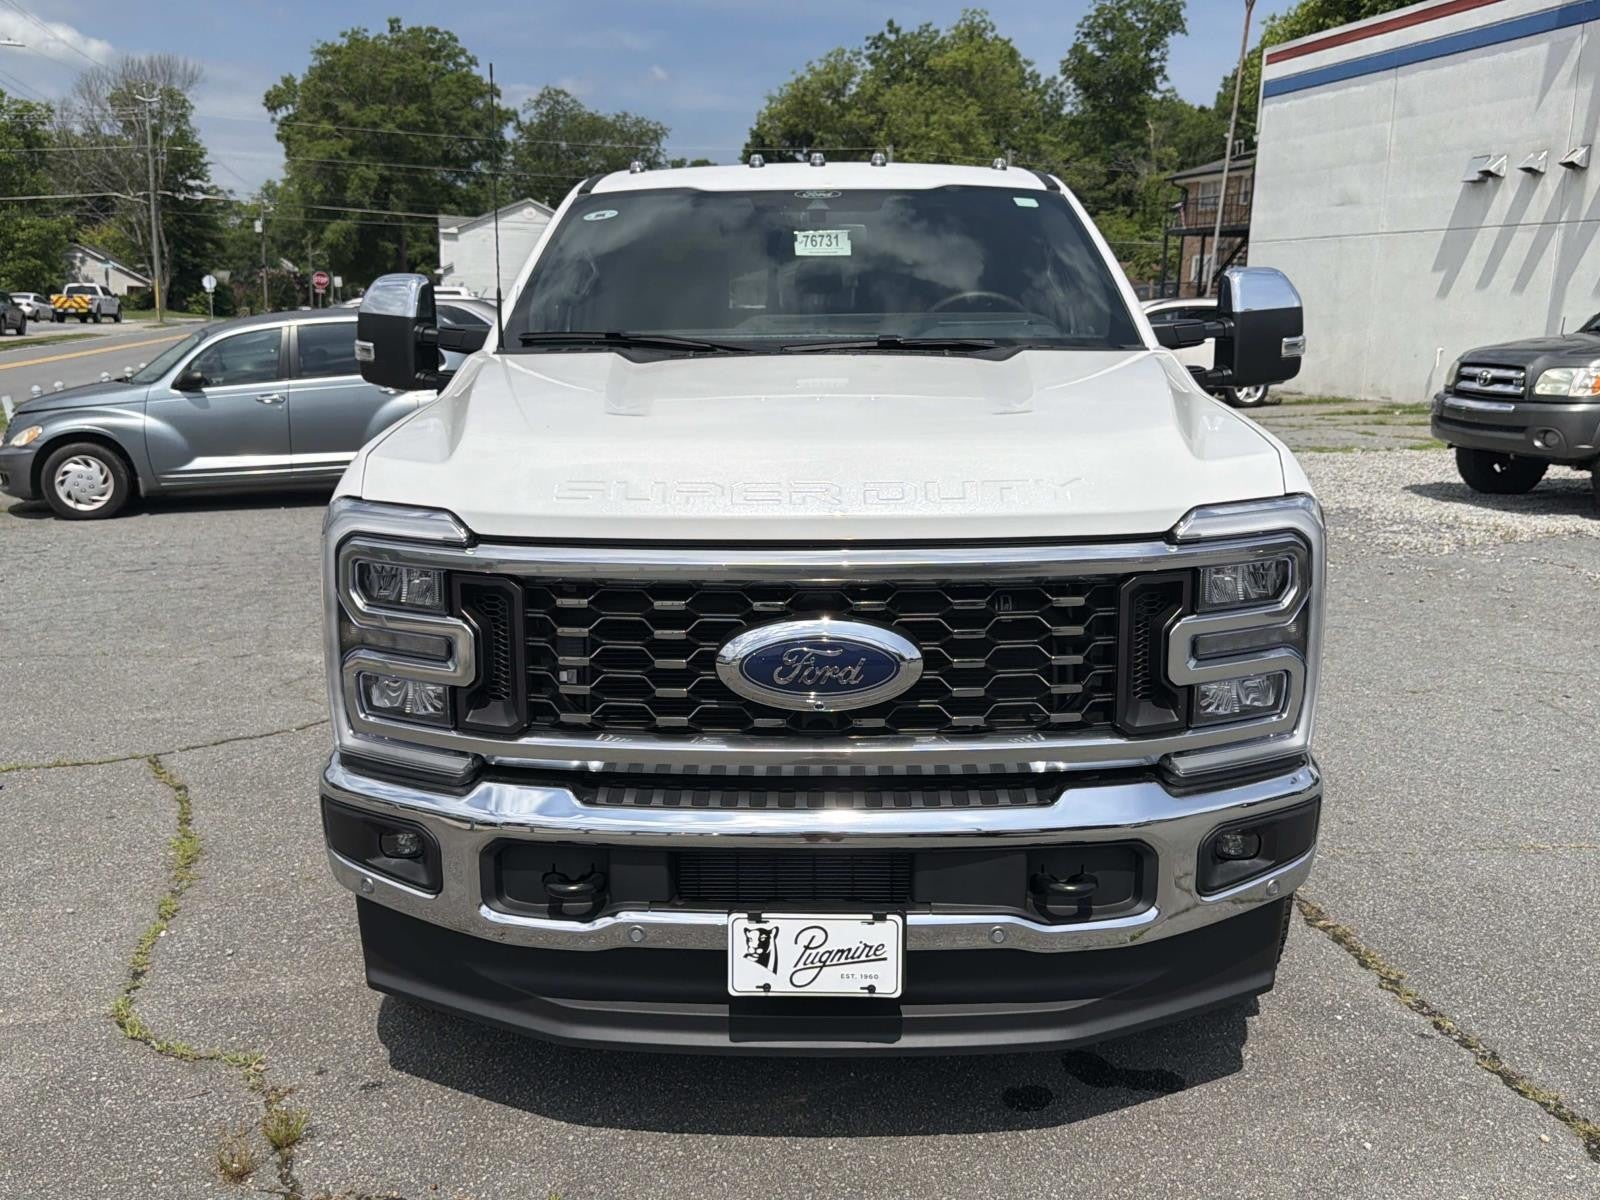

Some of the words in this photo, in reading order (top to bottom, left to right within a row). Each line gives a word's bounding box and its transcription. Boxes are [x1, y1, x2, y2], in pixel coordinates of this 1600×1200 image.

[803, 234, 839, 248] 76731
[554, 479, 845, 506] SUPER
[861, 479, 1085, 506] DUTY
[773, 647, 867, 685] Ford
[790, 925, 888, 988] Pugmire
